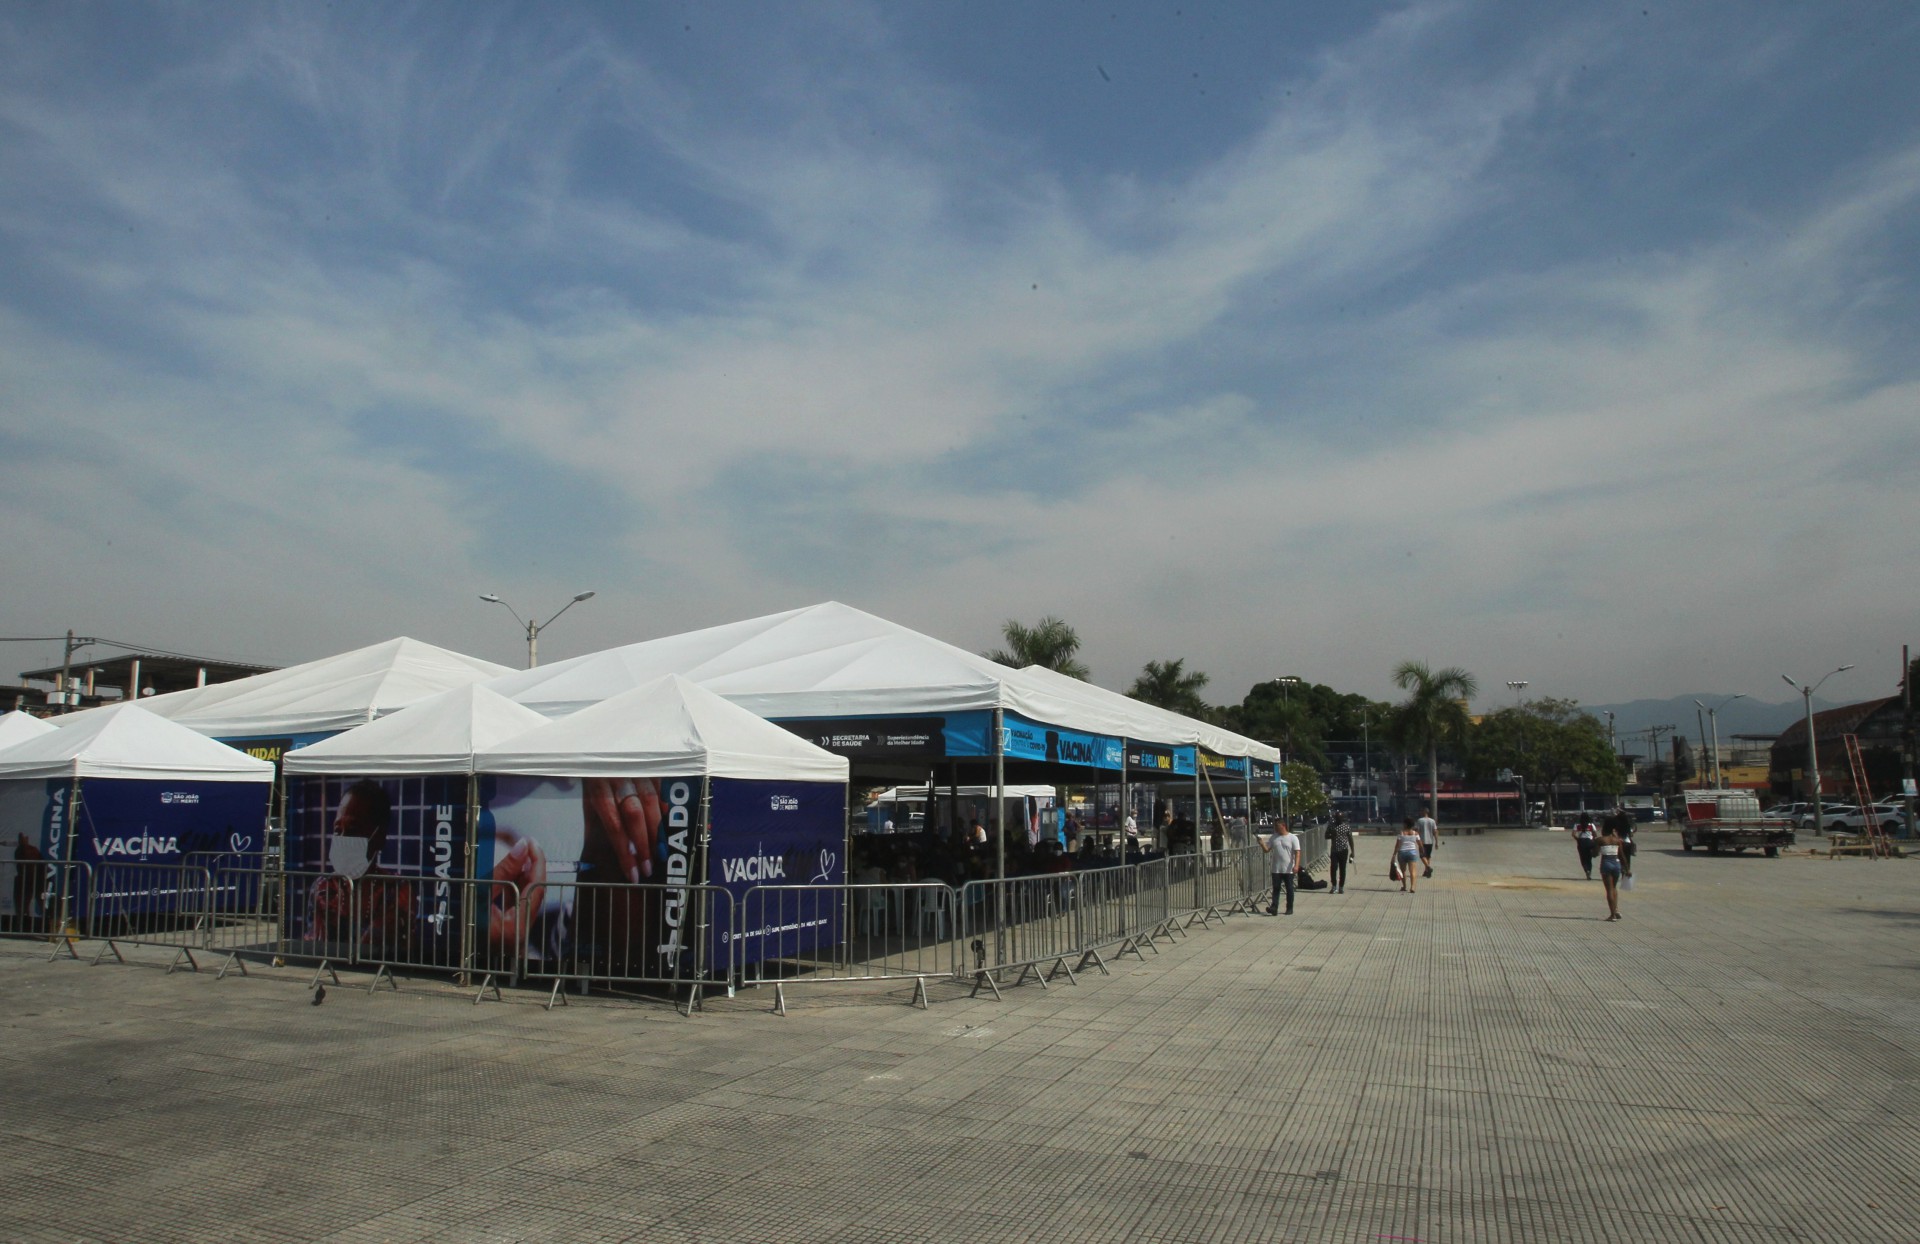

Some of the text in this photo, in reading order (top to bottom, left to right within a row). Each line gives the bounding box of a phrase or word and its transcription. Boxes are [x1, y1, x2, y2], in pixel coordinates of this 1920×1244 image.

[1060, 740, 1092, 763] VACINA
[93, 834, 181, 857] VACINA
[722, 852, 786, 883] VACINA
